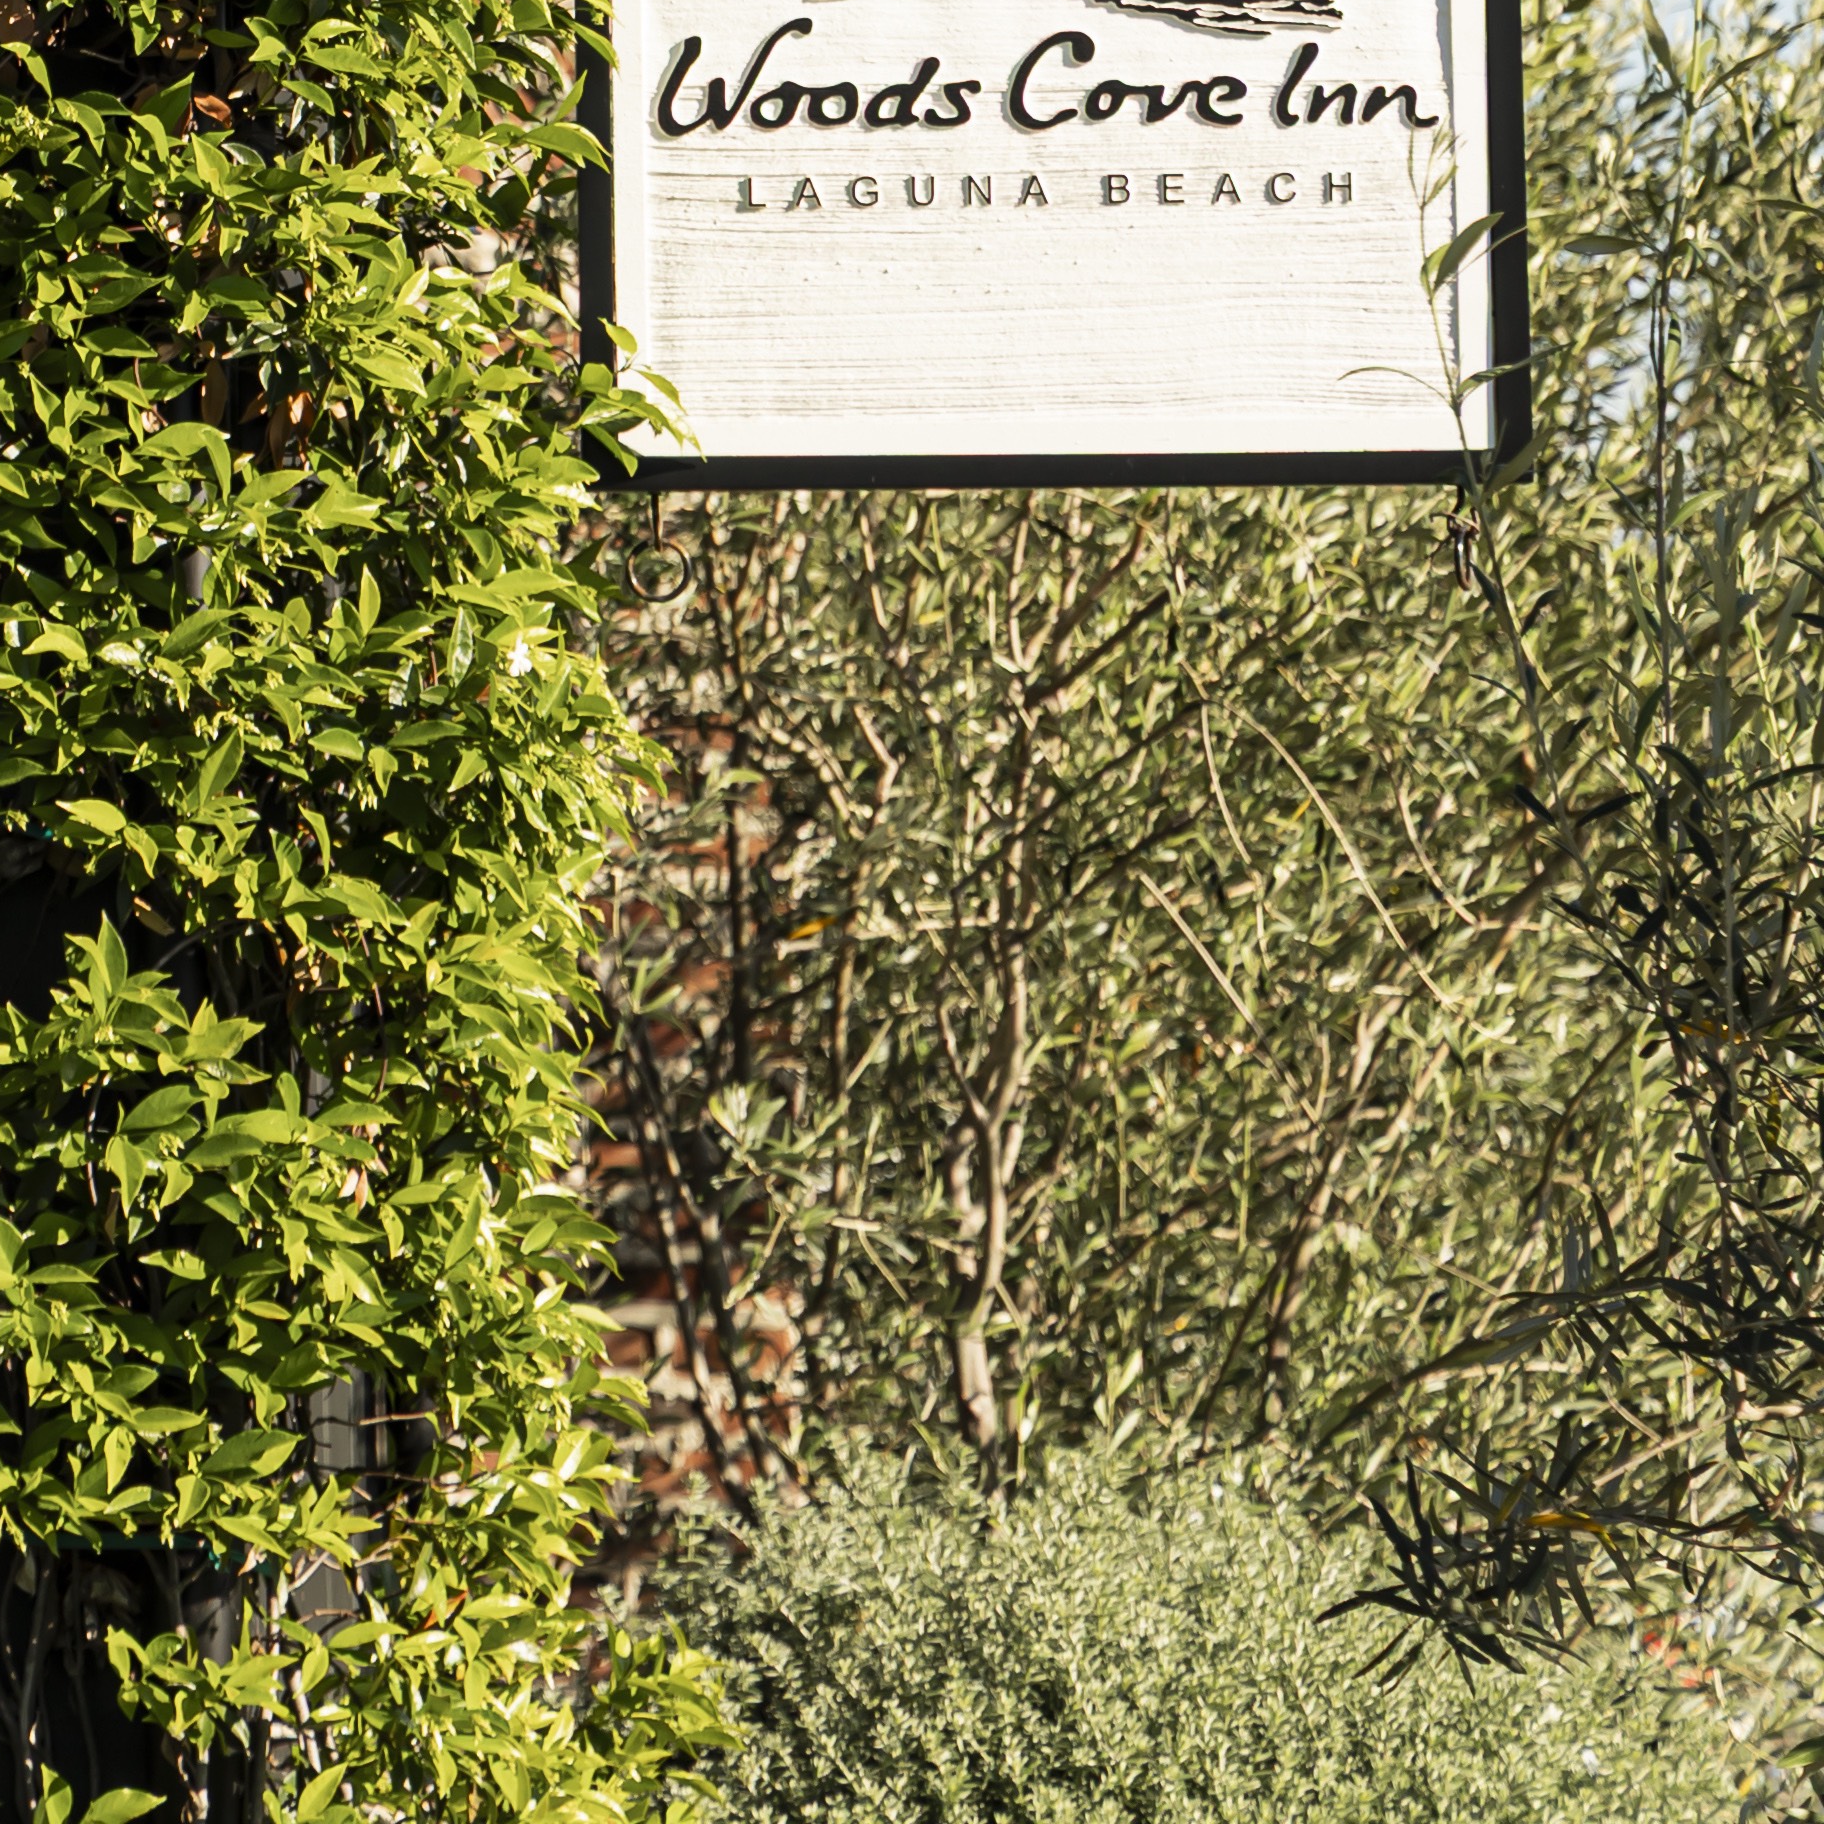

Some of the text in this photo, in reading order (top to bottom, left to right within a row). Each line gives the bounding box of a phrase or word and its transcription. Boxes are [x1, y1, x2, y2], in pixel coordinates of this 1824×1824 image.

[656, 18, 1440, 137] Woods Cove Inn
[745, 172, 1353, 208] LAGUNA BEACH
